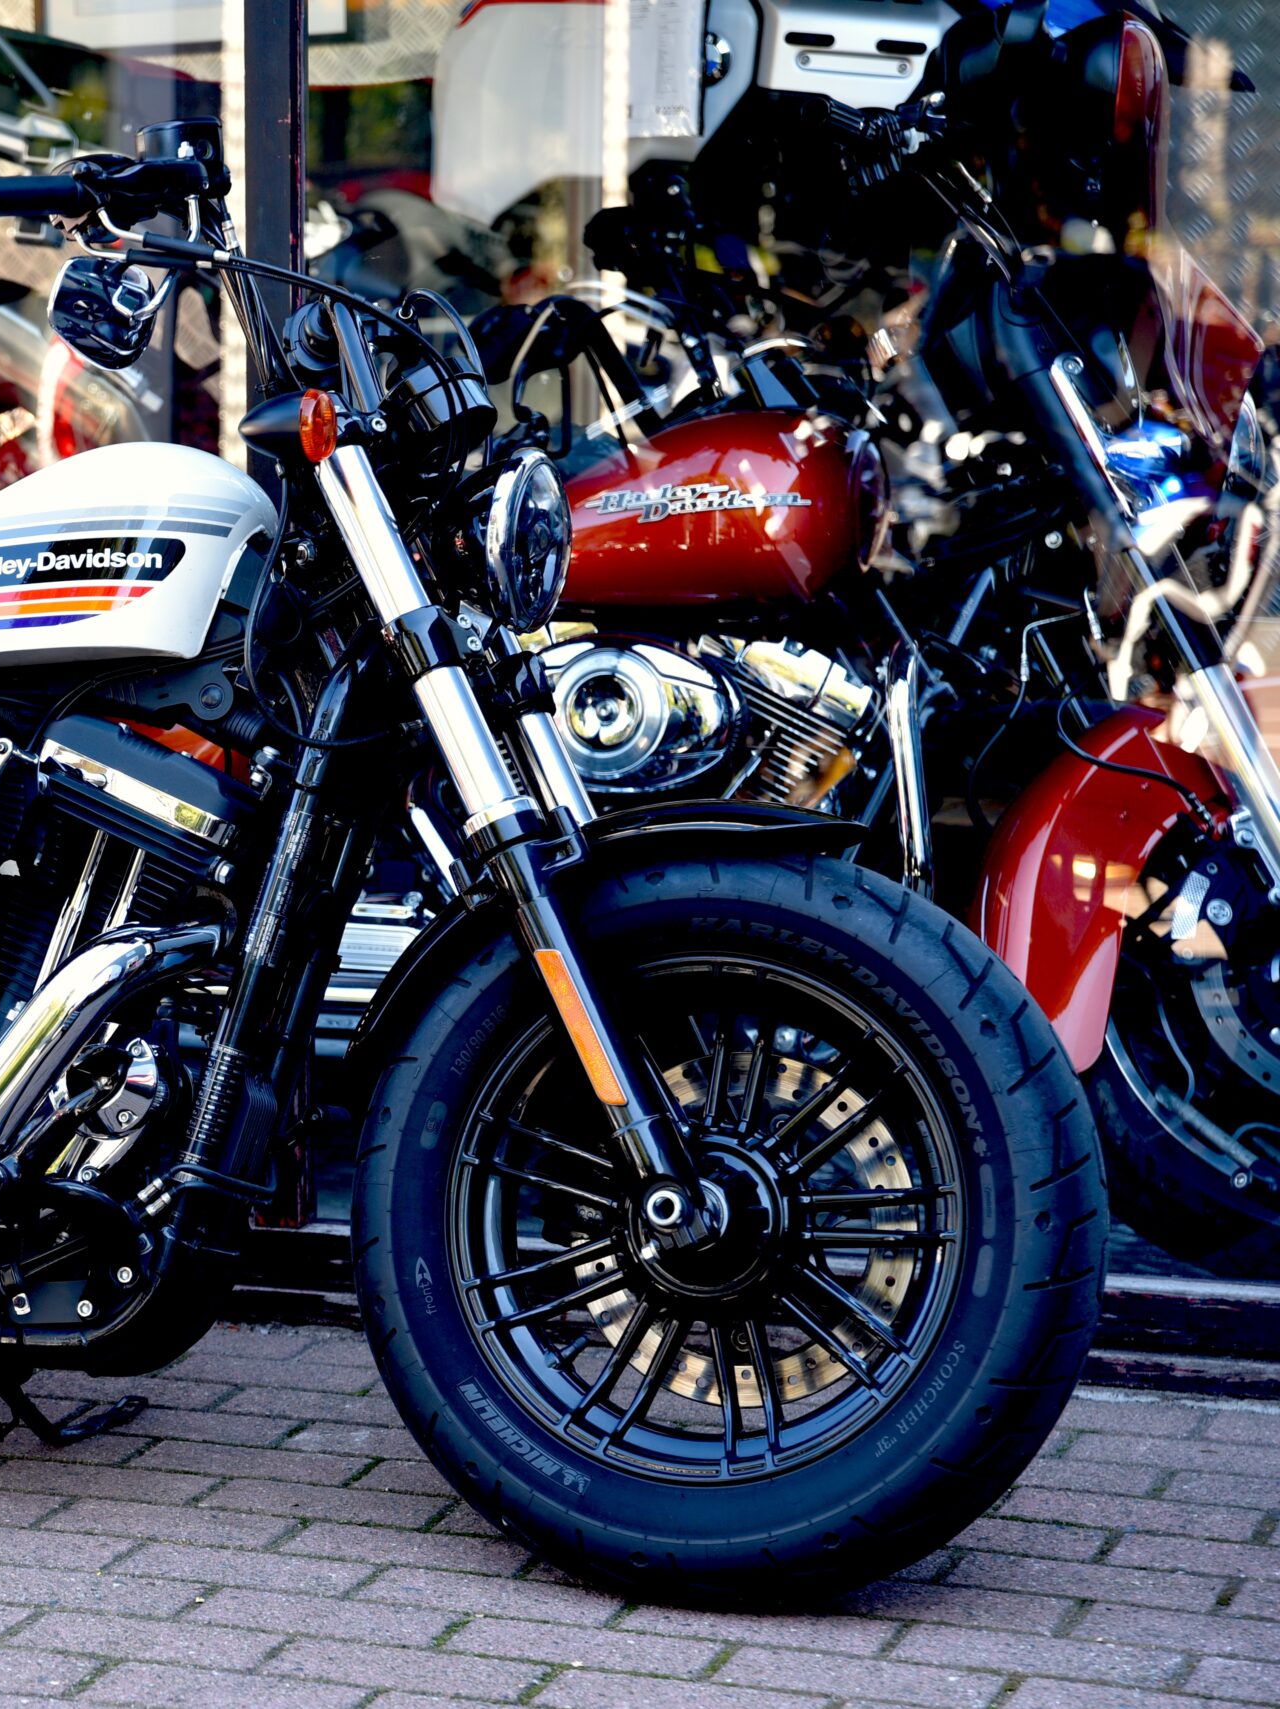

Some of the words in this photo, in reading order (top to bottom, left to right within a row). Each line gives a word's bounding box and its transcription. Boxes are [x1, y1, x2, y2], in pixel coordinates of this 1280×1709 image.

[450, 1028, 487, 1077] 130/90
[687, 917, 984, 1133] HARLEY-DAVIDSON
[418, 1281, 438, 1316] front
[458, 1382, 562, 1477] MICHELIN
[896, 1340, 966, 1435] SCORCHER
